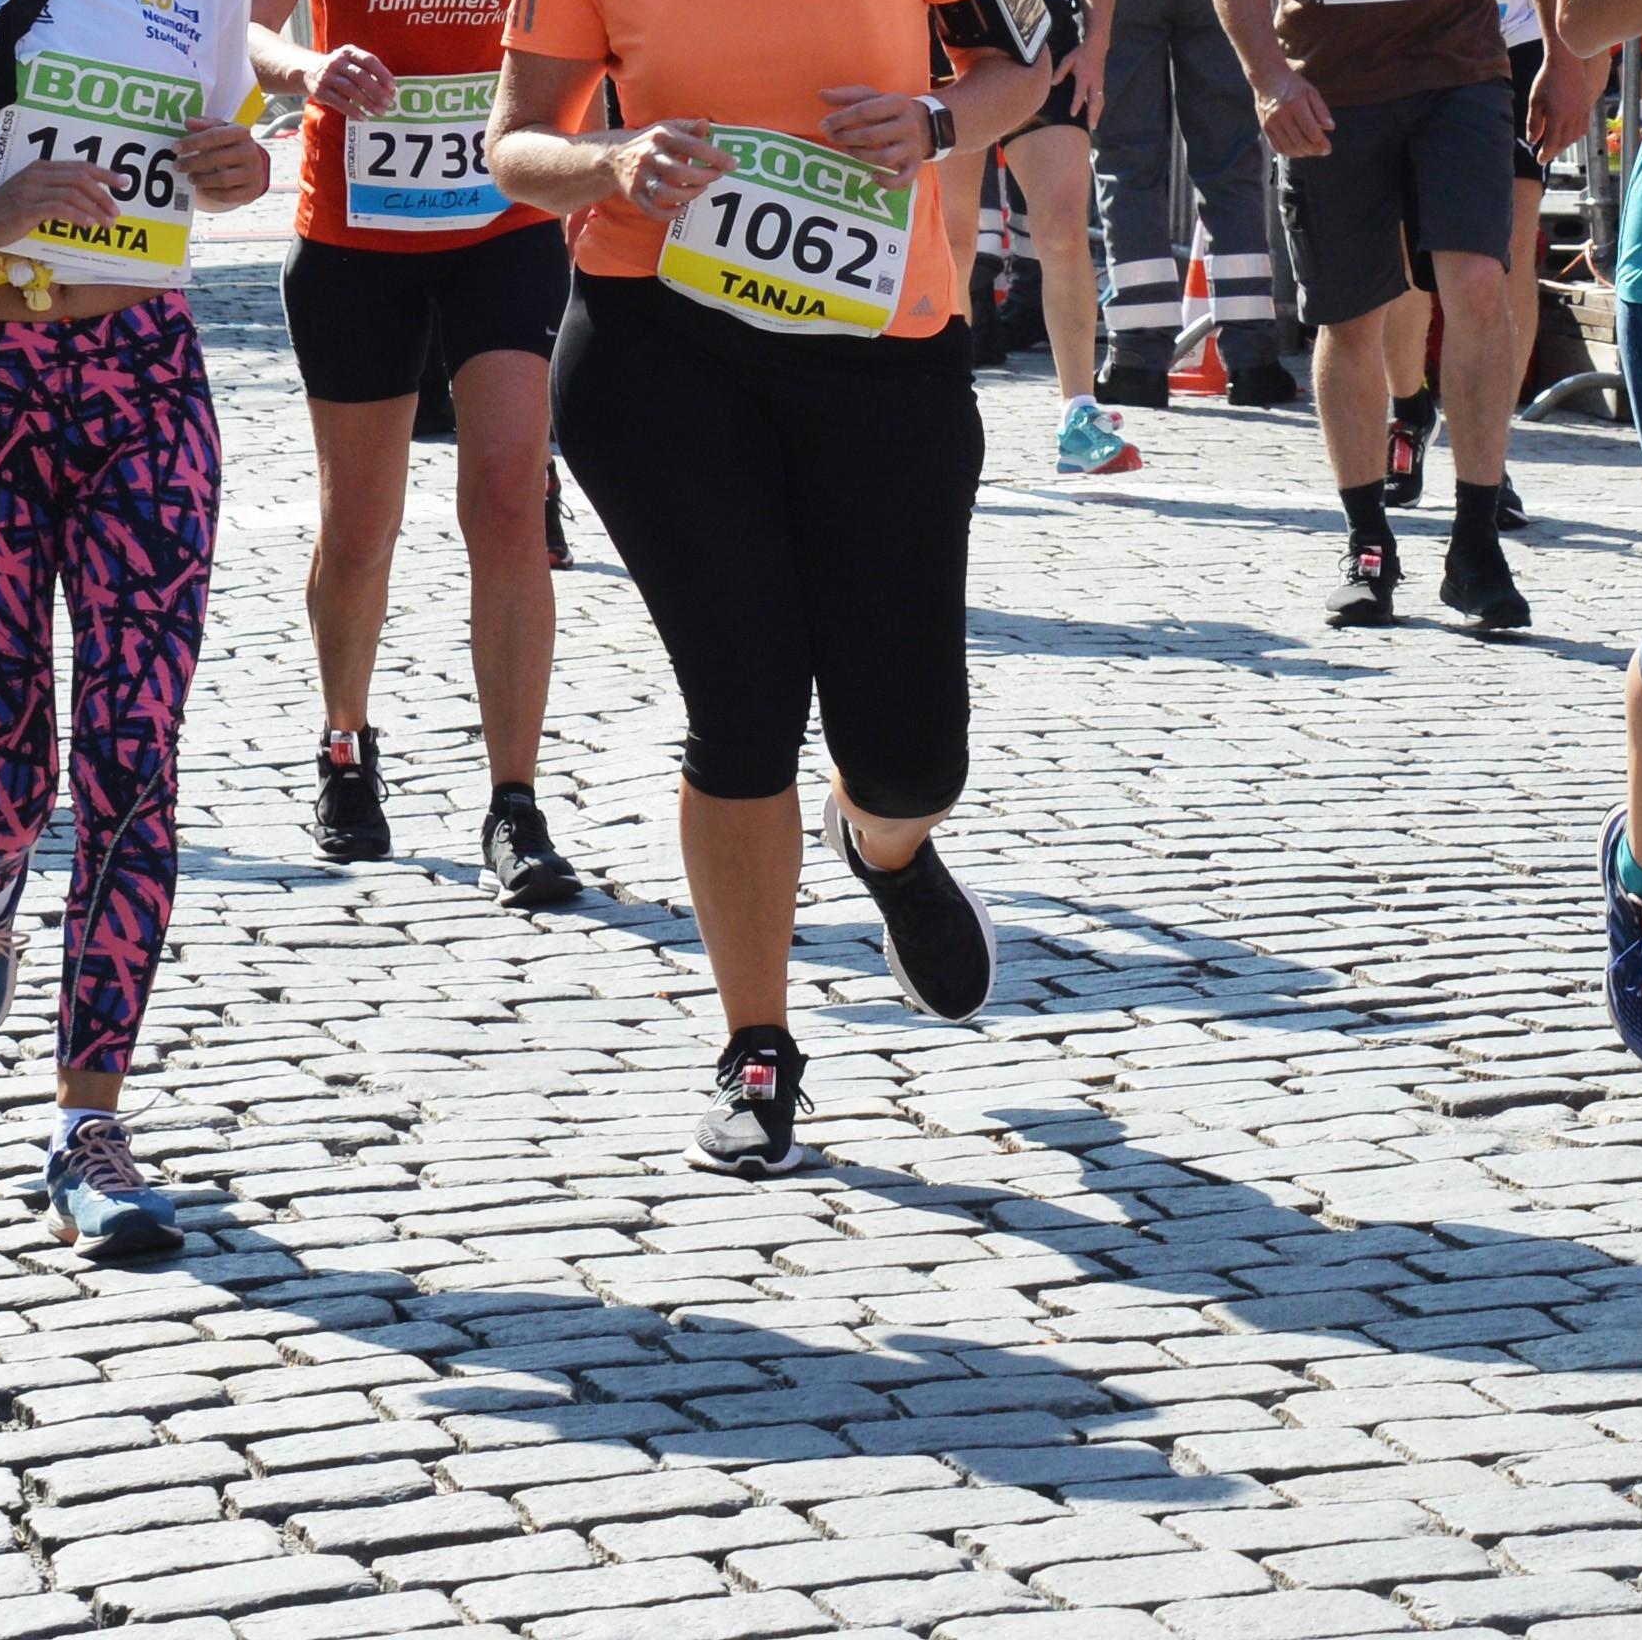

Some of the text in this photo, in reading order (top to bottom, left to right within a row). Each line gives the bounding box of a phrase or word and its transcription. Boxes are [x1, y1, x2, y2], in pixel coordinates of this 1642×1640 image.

[30, 64, 193, 126] BOCK
[387, 81, 490, 112] OCK
[717, 139, 887, 213] BOCK
[711, 191, 878, 290] 1062
[887, 244, 898, 255] D
[720, 270, 826, 317] TANJA
